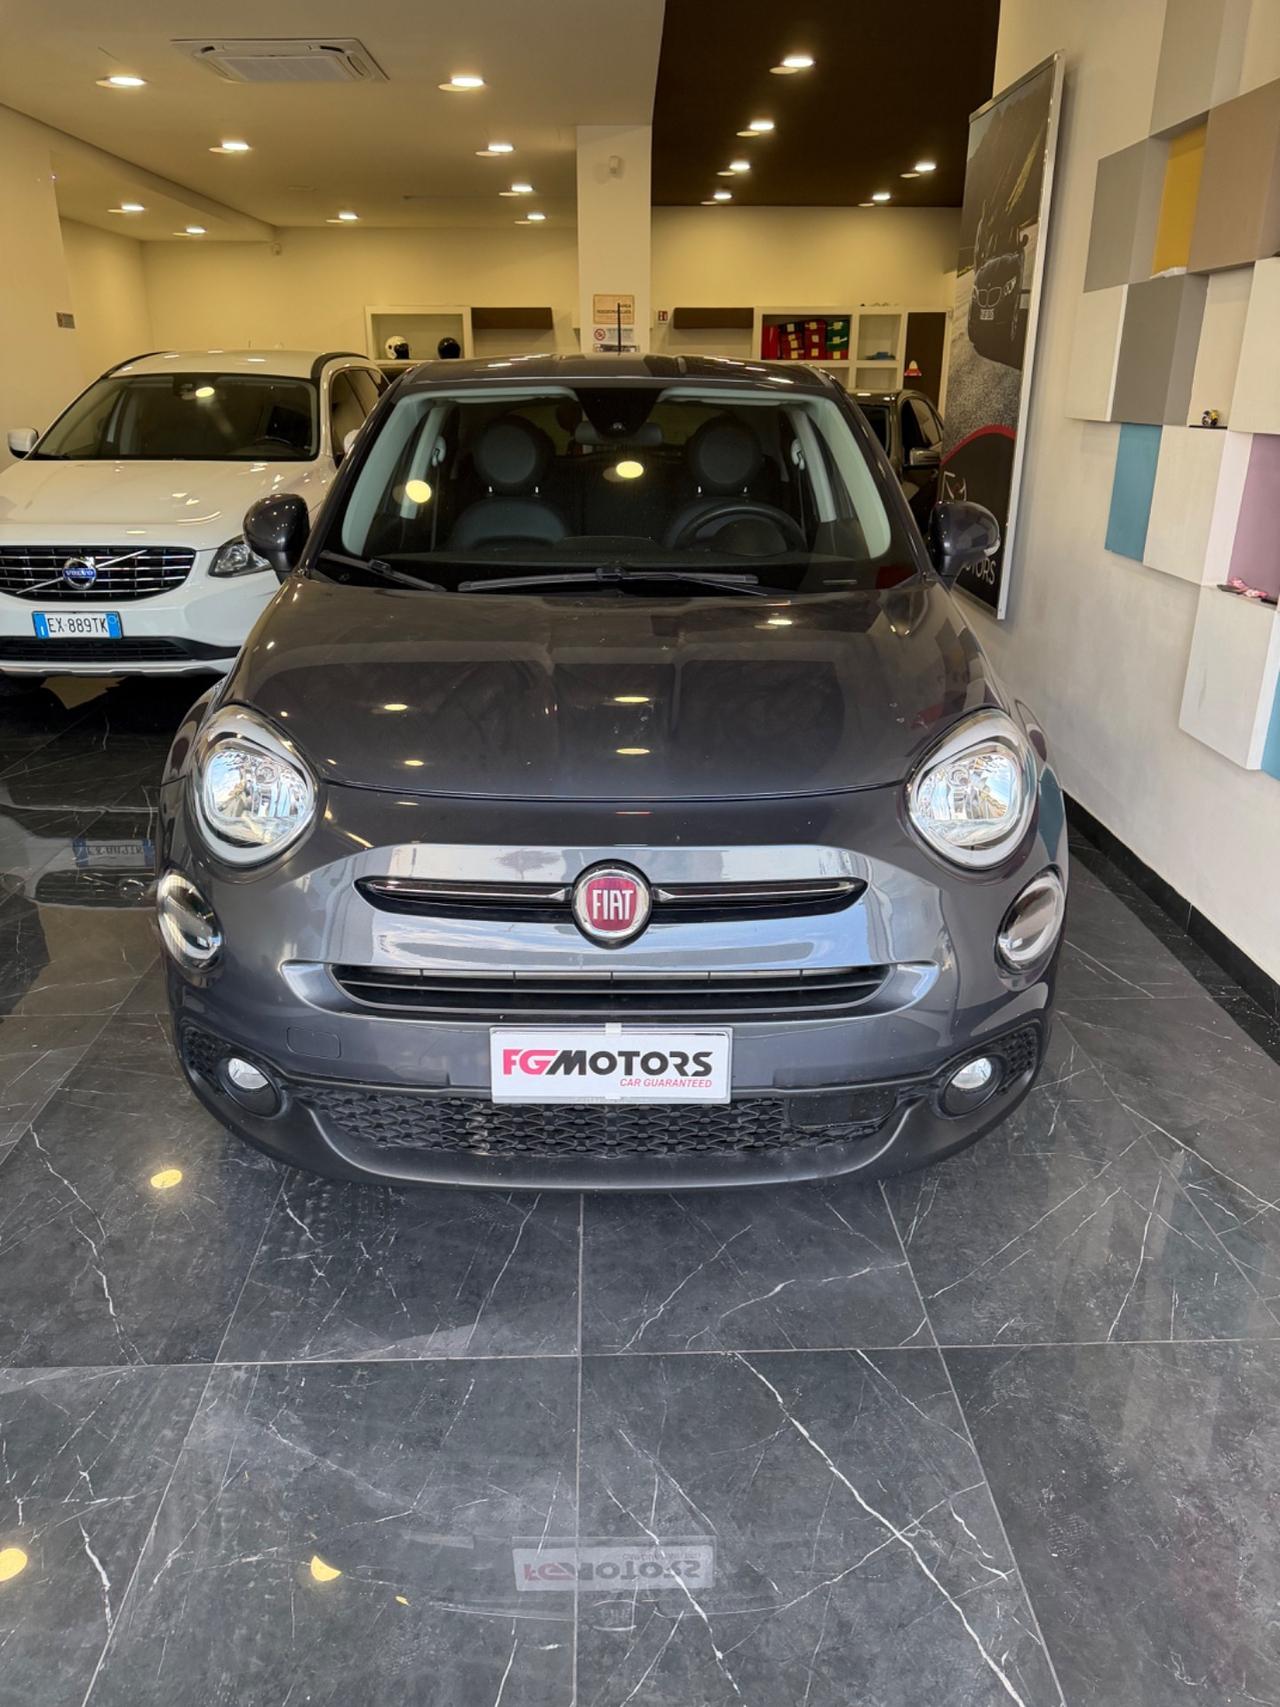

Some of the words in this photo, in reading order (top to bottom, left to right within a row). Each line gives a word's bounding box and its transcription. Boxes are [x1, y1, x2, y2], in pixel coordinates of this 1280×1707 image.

[47, 617, 65, 633] EX
[67, 617, 108, 633] 889TK
[592, 889, 635, 921] FIAT
[619, 1078, 642, 1087] CAR
[643, 1079, 713, 1088] GUARANTEED
